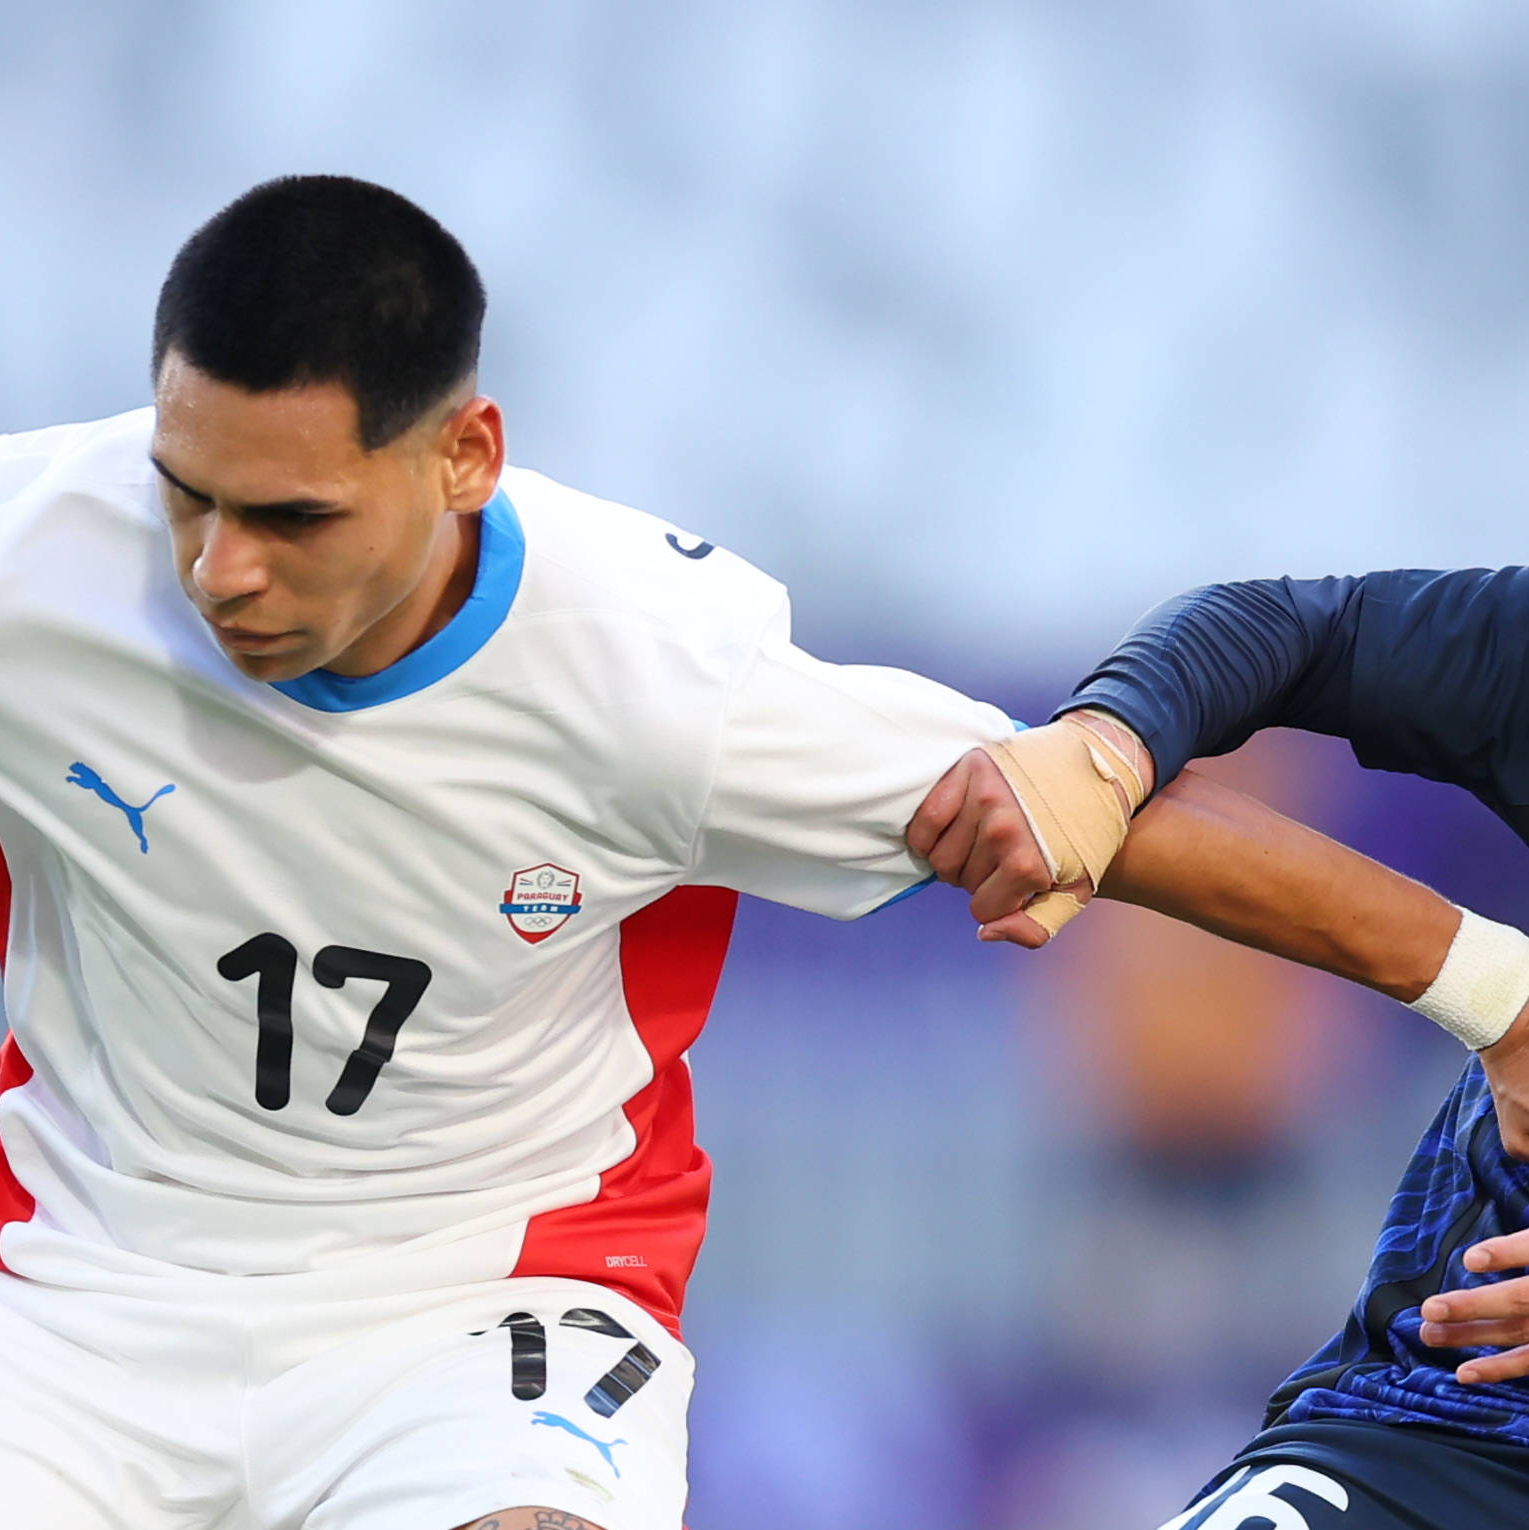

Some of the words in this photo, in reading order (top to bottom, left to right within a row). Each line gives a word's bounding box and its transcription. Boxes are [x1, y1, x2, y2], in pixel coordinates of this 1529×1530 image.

[517, 892, 569, 902] PARAGUAY
[217, 932, 432, 1116] 17
[605, 1255, 648, 1267] DRYCELL
[467, 1308, 661, 1418] 17
